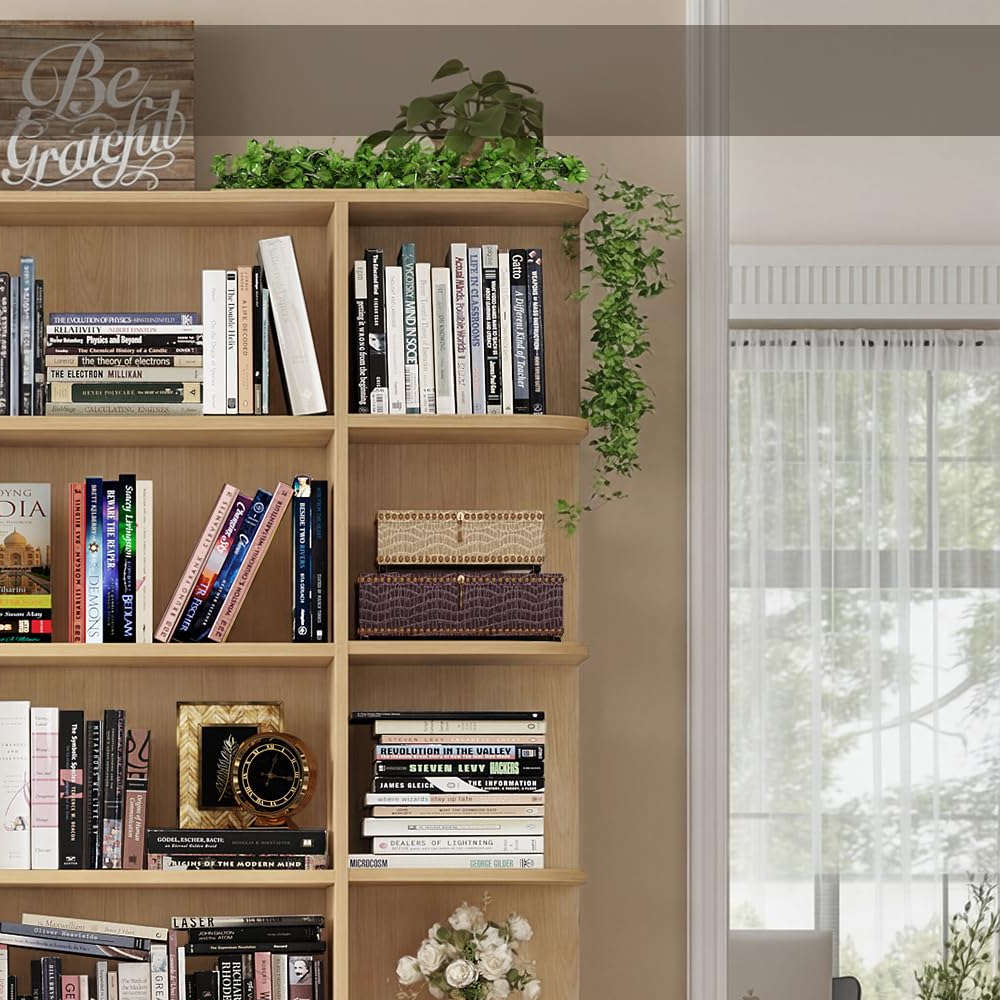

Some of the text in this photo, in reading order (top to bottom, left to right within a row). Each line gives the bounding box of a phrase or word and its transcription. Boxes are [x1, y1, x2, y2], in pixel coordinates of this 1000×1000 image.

[22, 32, 152, 122] Be
[2, 89, 186, 190] Grateful
[512, 255, 524, 279] Gatto
[514, 298, 525, 330] Different
[516, 332, 525, 348] Kind
[517, 361, 526, 388] Teacher
[107, 490, 116, 568] BEWARE THE REAPER
[87, 576, 100, 638] DEMONS
[122, 595, 133, 636] BEDLAM
[93, 782, 98, 792] WE
[93, 825, 97, 835] BY
[173, 918, 215, 928] LASER
